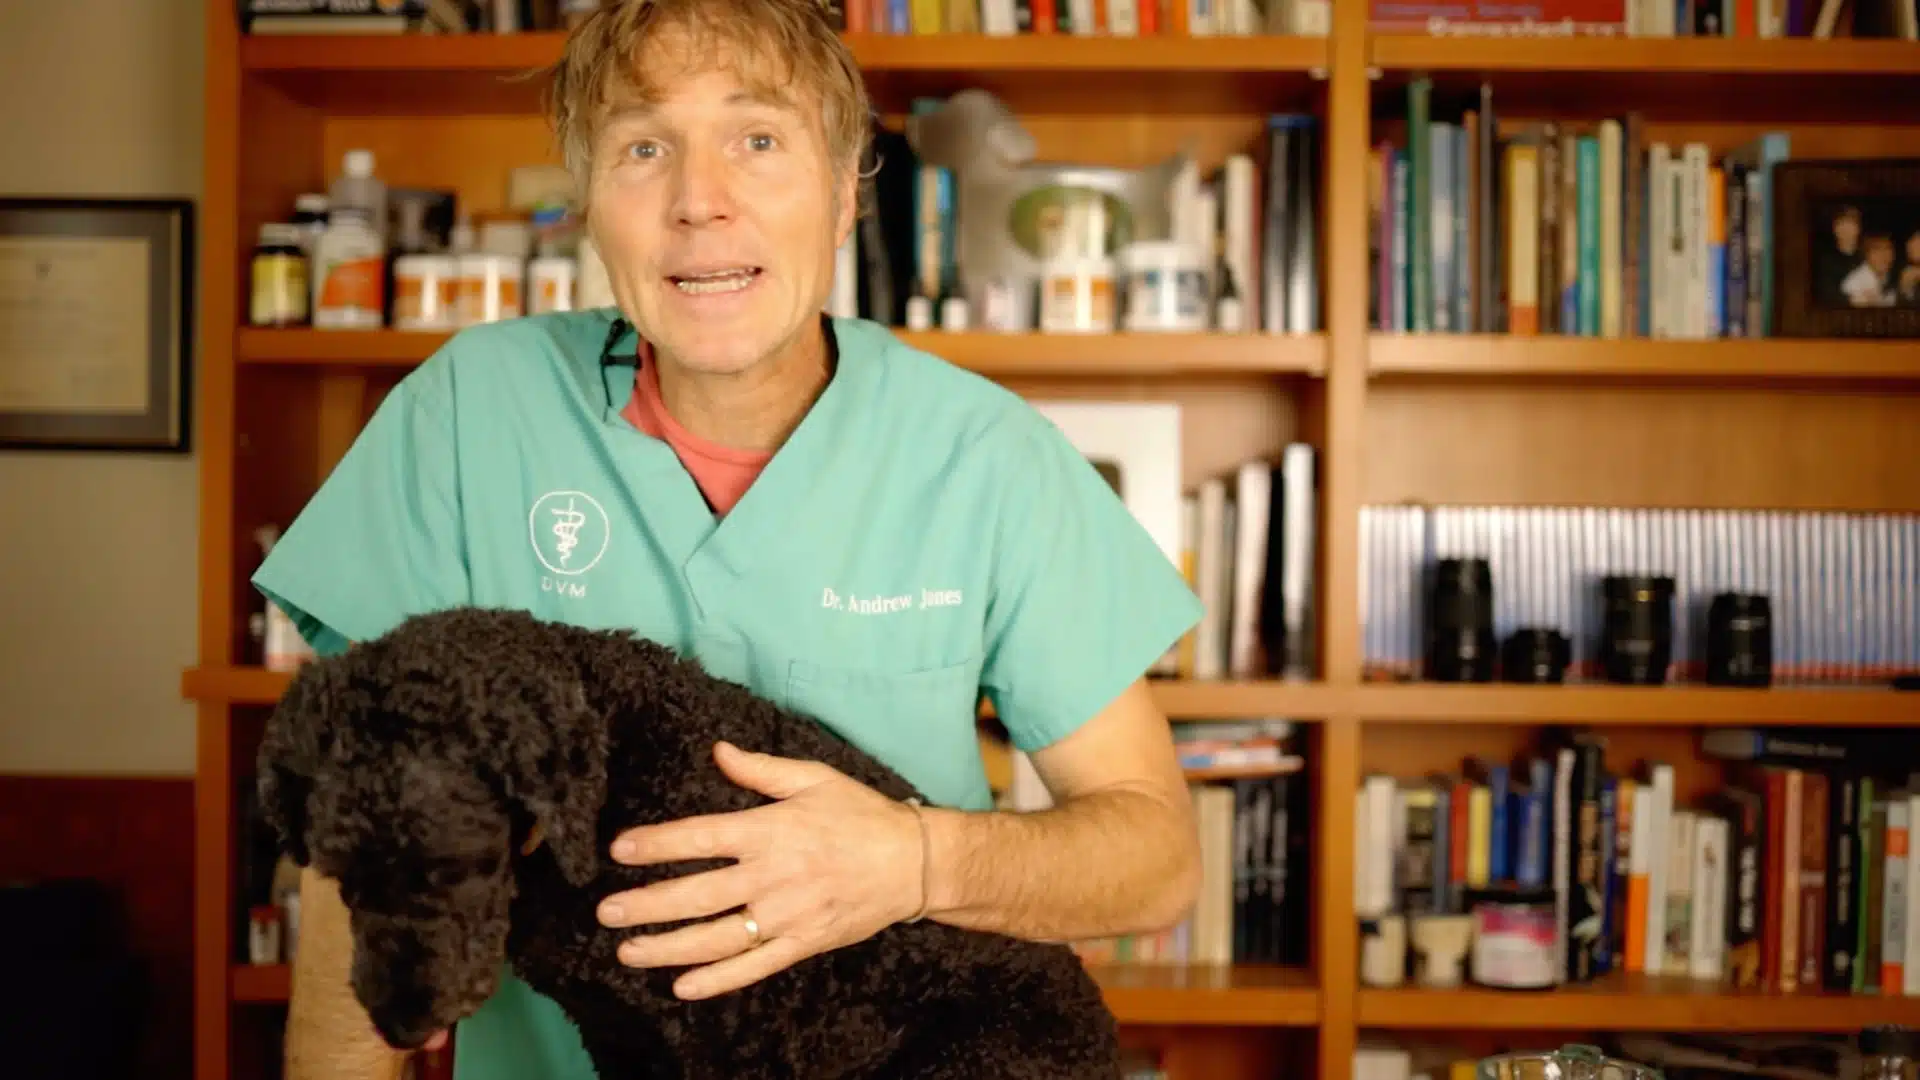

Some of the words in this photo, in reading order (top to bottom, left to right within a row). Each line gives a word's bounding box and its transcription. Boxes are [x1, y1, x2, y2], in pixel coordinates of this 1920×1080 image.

[541, 577, 587, 597] DVM
[822, 587, 844, 610] Dr.
[848, 593, 912, 614] Andrew
[920, 588, 963, 609] Jones
